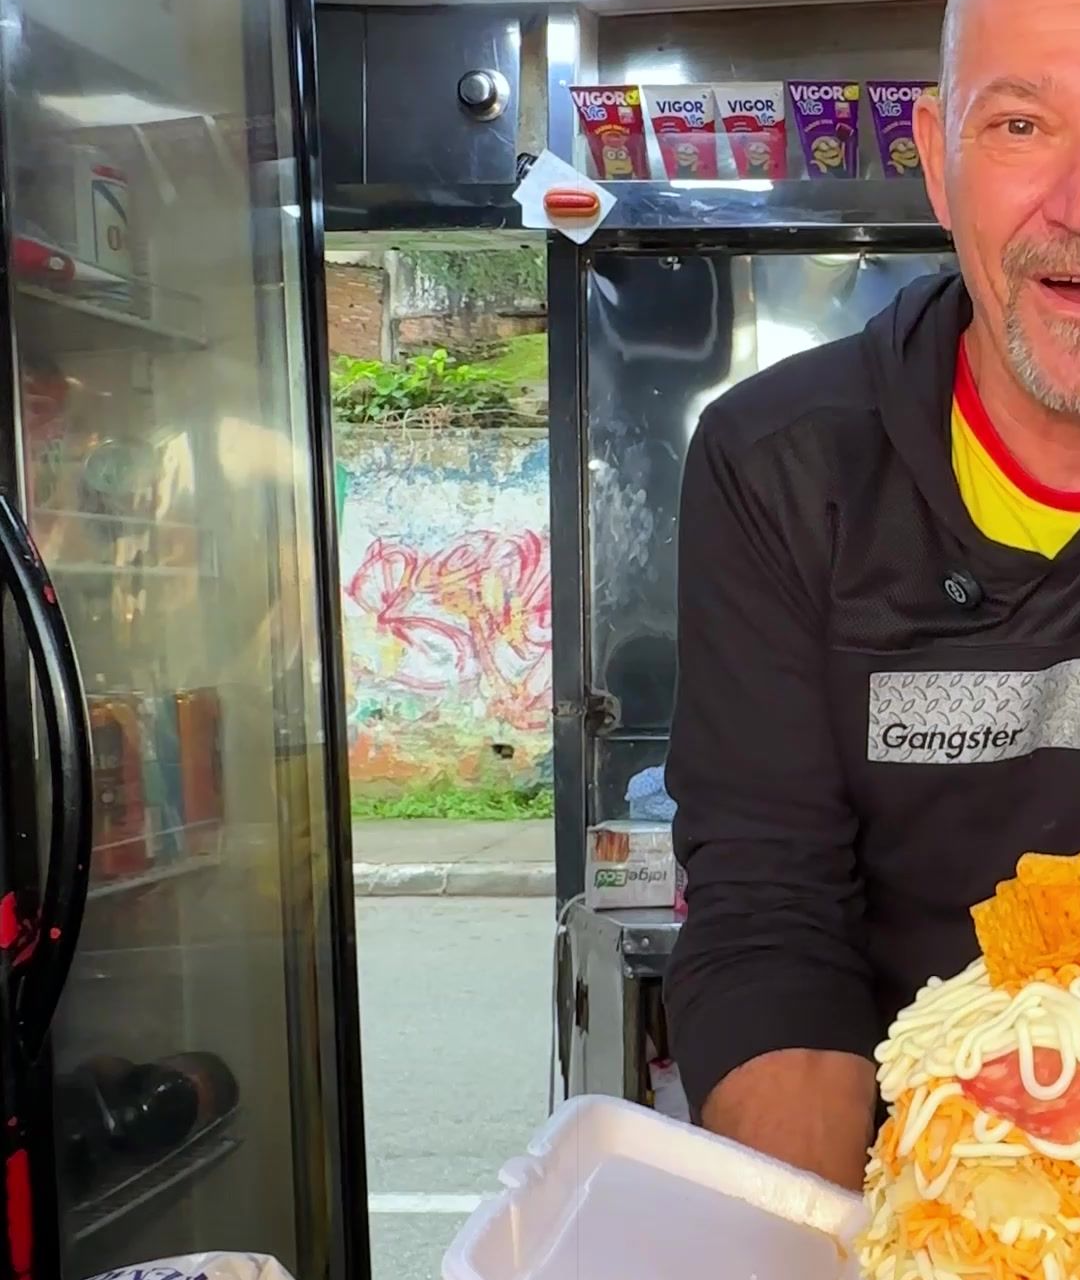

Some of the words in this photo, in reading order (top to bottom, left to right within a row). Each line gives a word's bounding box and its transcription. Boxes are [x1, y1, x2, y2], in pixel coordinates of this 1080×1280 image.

[572, 91, 627, 106] VIGOR
[790, 85, 845, 101] VIGOR
[869, 87, 922, 102] VIGOR
[656, 101, 704, 114] VIGOR
[728, 100, 776, 112] VIGOR
[882, 723, 1023, 759] Gangster
